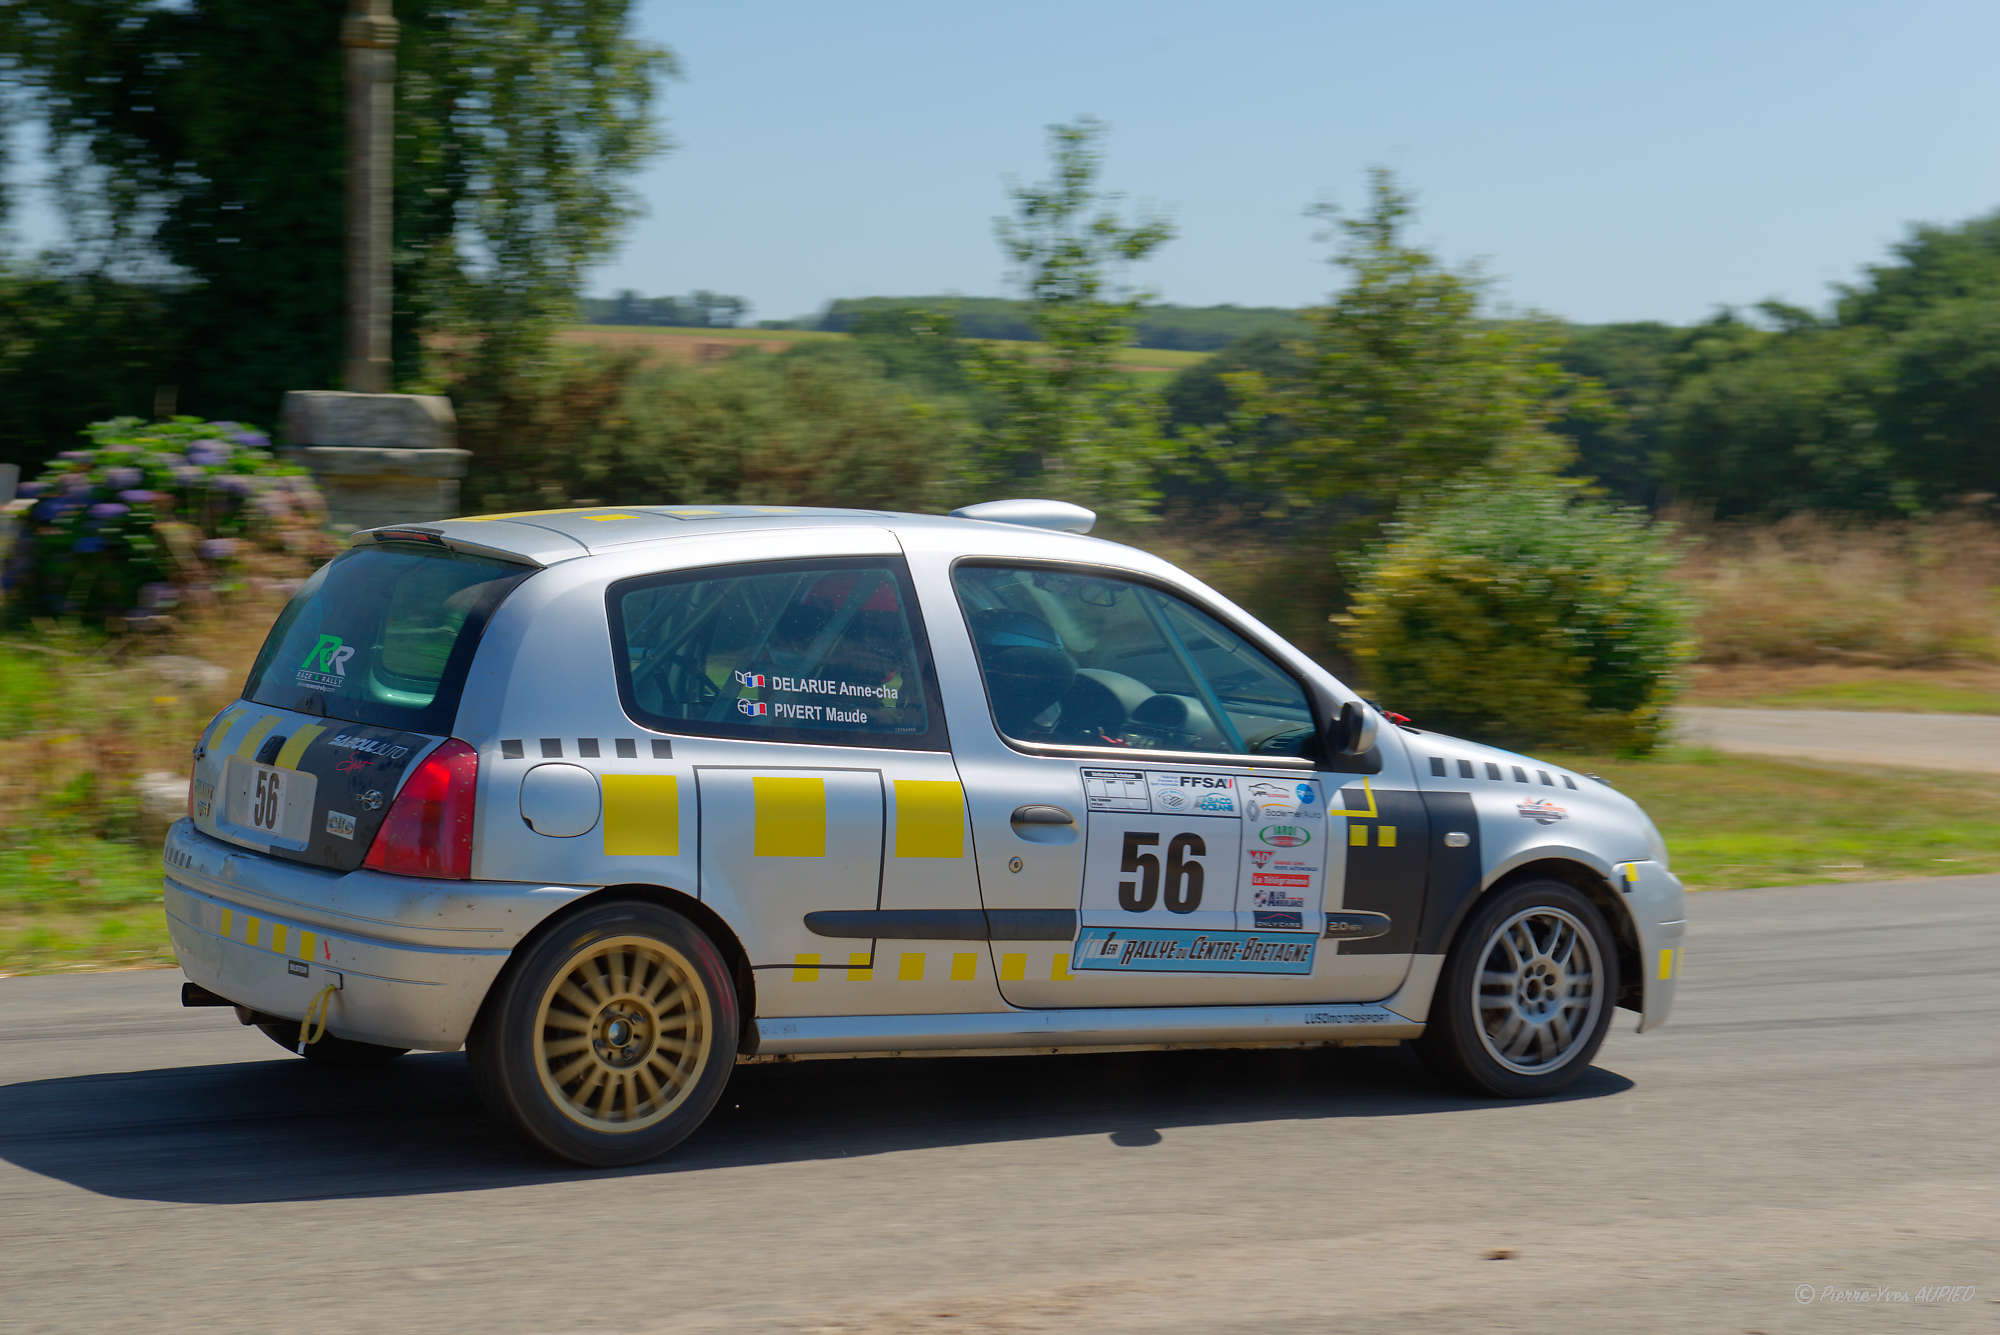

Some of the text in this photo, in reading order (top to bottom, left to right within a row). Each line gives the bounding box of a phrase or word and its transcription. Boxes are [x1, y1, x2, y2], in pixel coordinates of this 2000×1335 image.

[772, 676, 899, 699] DELARUE Anne-cha
[774, 703, 868, 724] PIVERT Maude
[1180, 776, 1227, 789] FFSA
[255, 770, 280, 830] 56
[1118, 831, 1207, 915] 56
[1120, 940, 1179, 965] RALLYE
